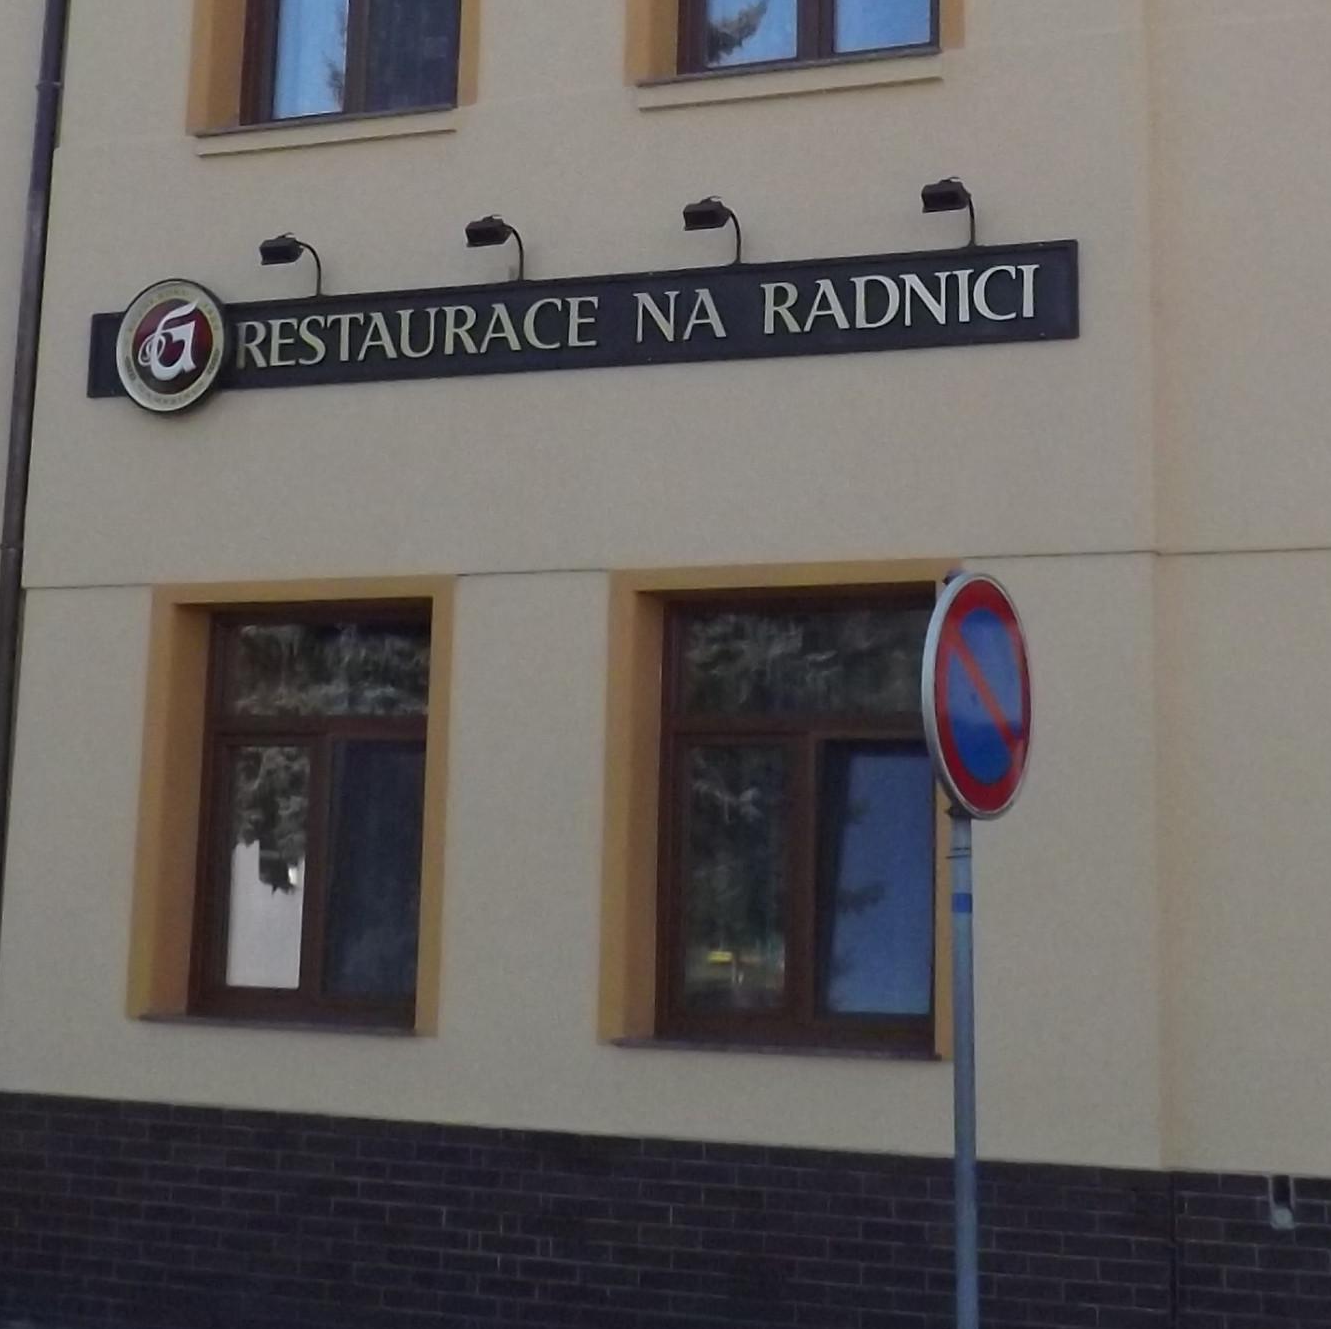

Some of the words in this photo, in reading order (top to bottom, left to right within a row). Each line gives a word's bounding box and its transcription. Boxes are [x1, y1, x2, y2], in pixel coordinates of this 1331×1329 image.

[235, 296, 600, 370] RESTAURACE
[632, 288, 727, 343] NA
[760, 264, 1040, 335] RADNICI
